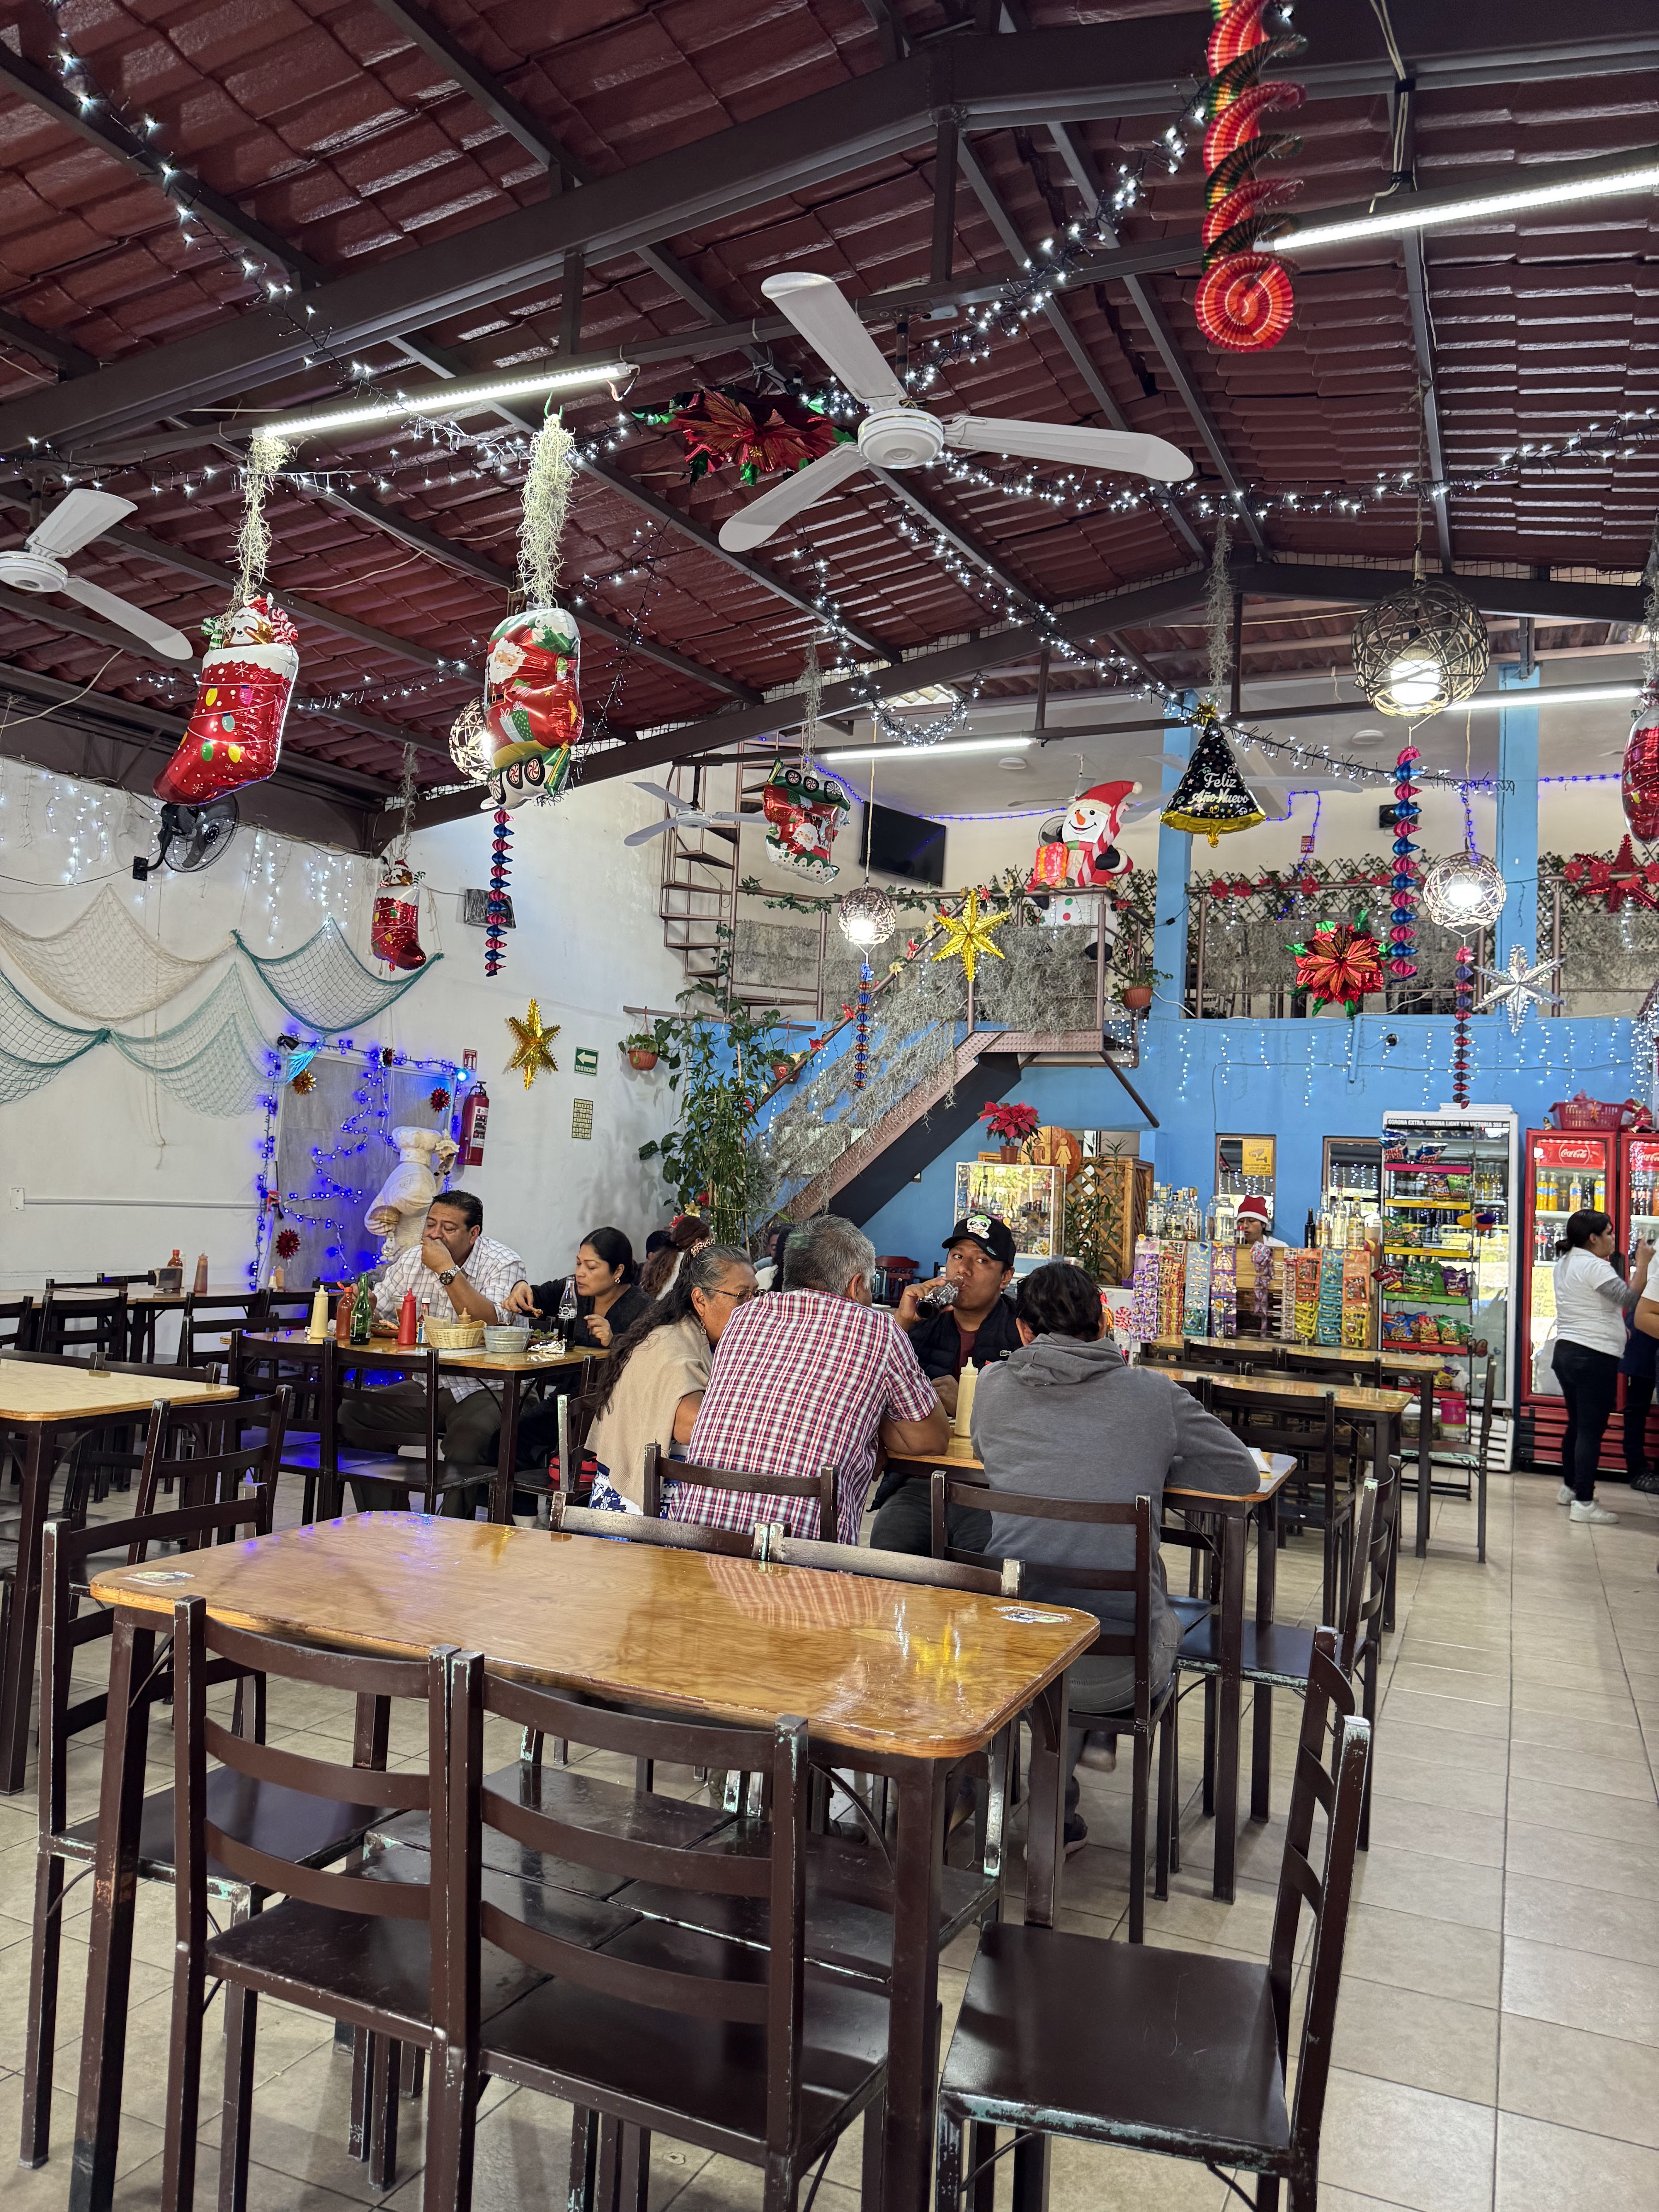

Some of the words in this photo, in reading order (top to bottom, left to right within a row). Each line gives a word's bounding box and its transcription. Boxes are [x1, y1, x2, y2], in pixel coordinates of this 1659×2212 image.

[1204, 772, 1237, 788] Feliz
[1188, 789, 1218, 804] Año
[1216, 788, 1249, 803] Nuevo
